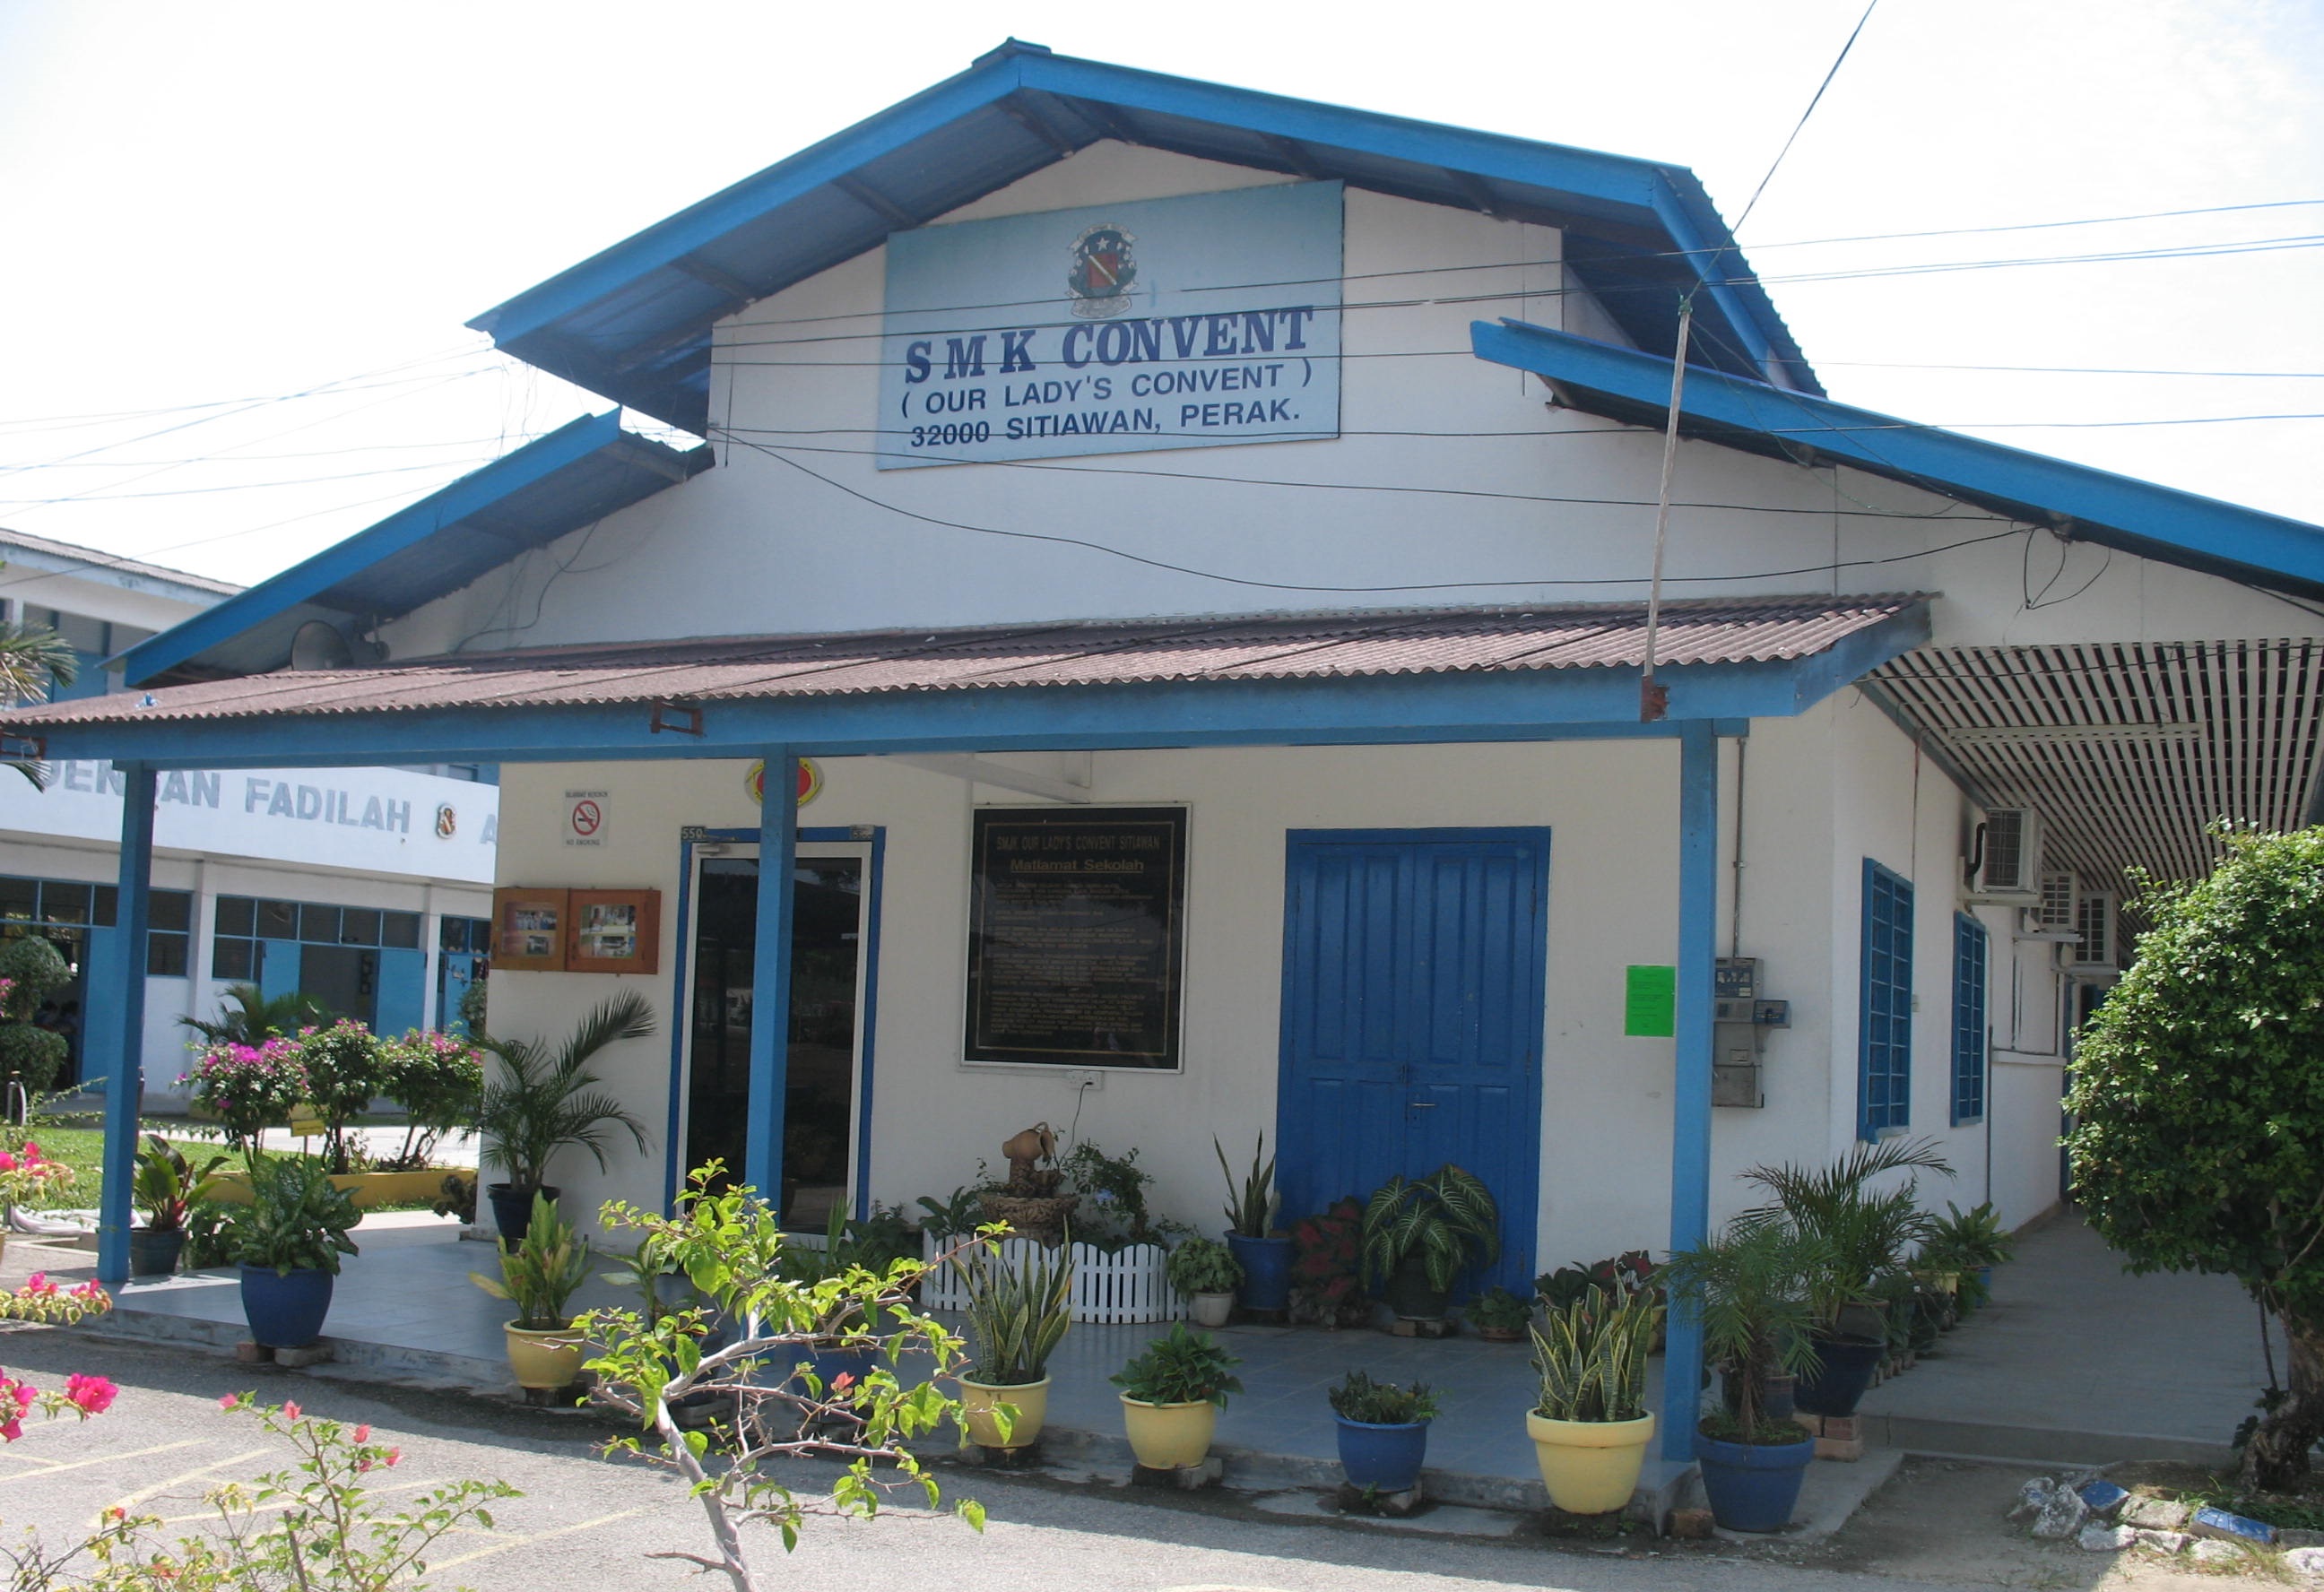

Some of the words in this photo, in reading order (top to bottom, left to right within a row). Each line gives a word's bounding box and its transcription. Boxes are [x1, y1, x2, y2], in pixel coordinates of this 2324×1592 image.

[1062, 307, 1314, 369] CONVENT
[1005, 375, 1112, 408] LADY'S
[1132, 363, 1284, 397] CONVENT
[910, 420, 990, 447] 32000
[1006, 406, 1160, 439] SITIAWAN,
[1180, 398, 1300, 428] PERAK.
[245, 777, 412, 834] FADILAH
[1010, 858, 1077, 871] Matlamat
[1084, 858, 1145, 871] Sekolah
[1076, 835, 1114, 851] CONVENT
[1119, 835, 1161, 851] SITIAWAN
